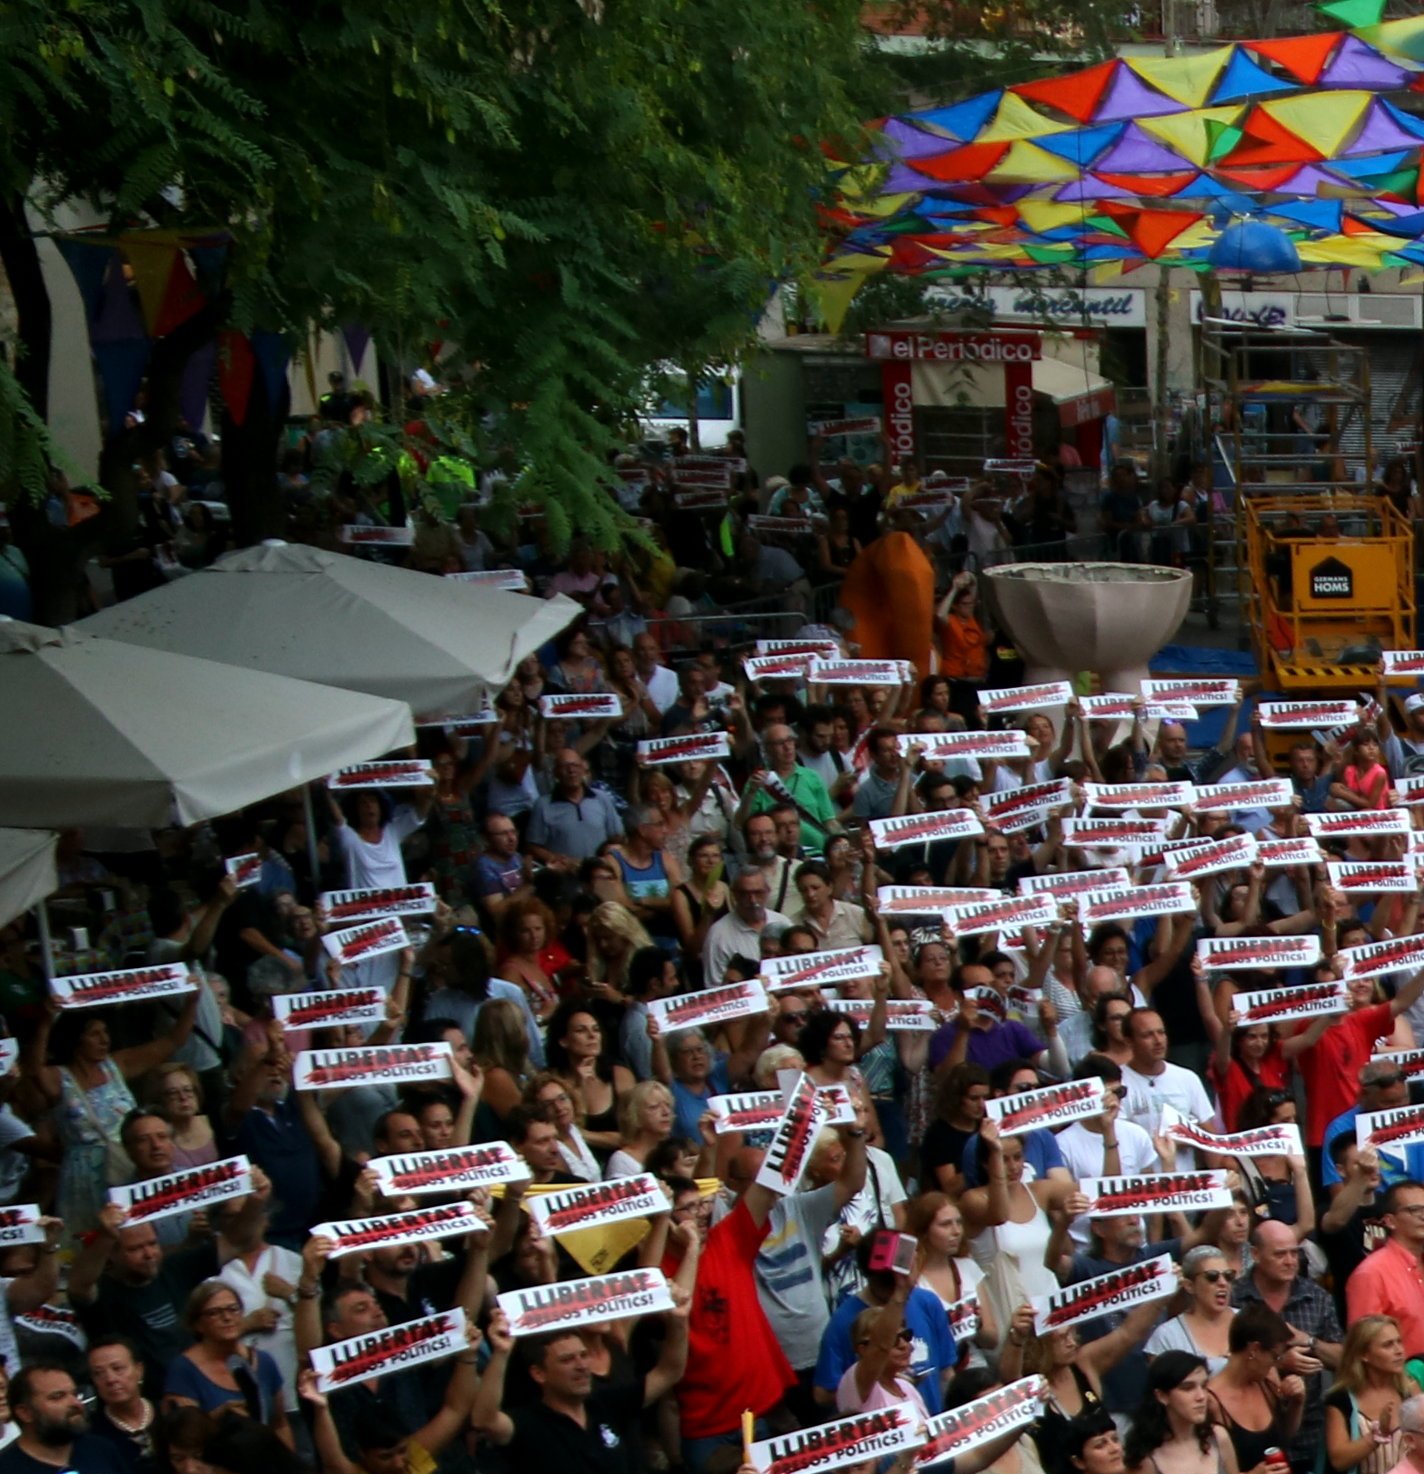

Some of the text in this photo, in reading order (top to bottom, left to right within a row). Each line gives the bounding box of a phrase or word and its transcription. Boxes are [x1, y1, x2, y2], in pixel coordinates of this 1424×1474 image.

[922, 336, 1032, 360] Periódico
[1314, 583, 1349, 592] HOMS
[517, 1274, 648, 1314] LLIBERTAT
[1048, 1264, 1157, 1314] LLIBERTAT
[329, 1317, 448, 1368] LLIBERTAT
